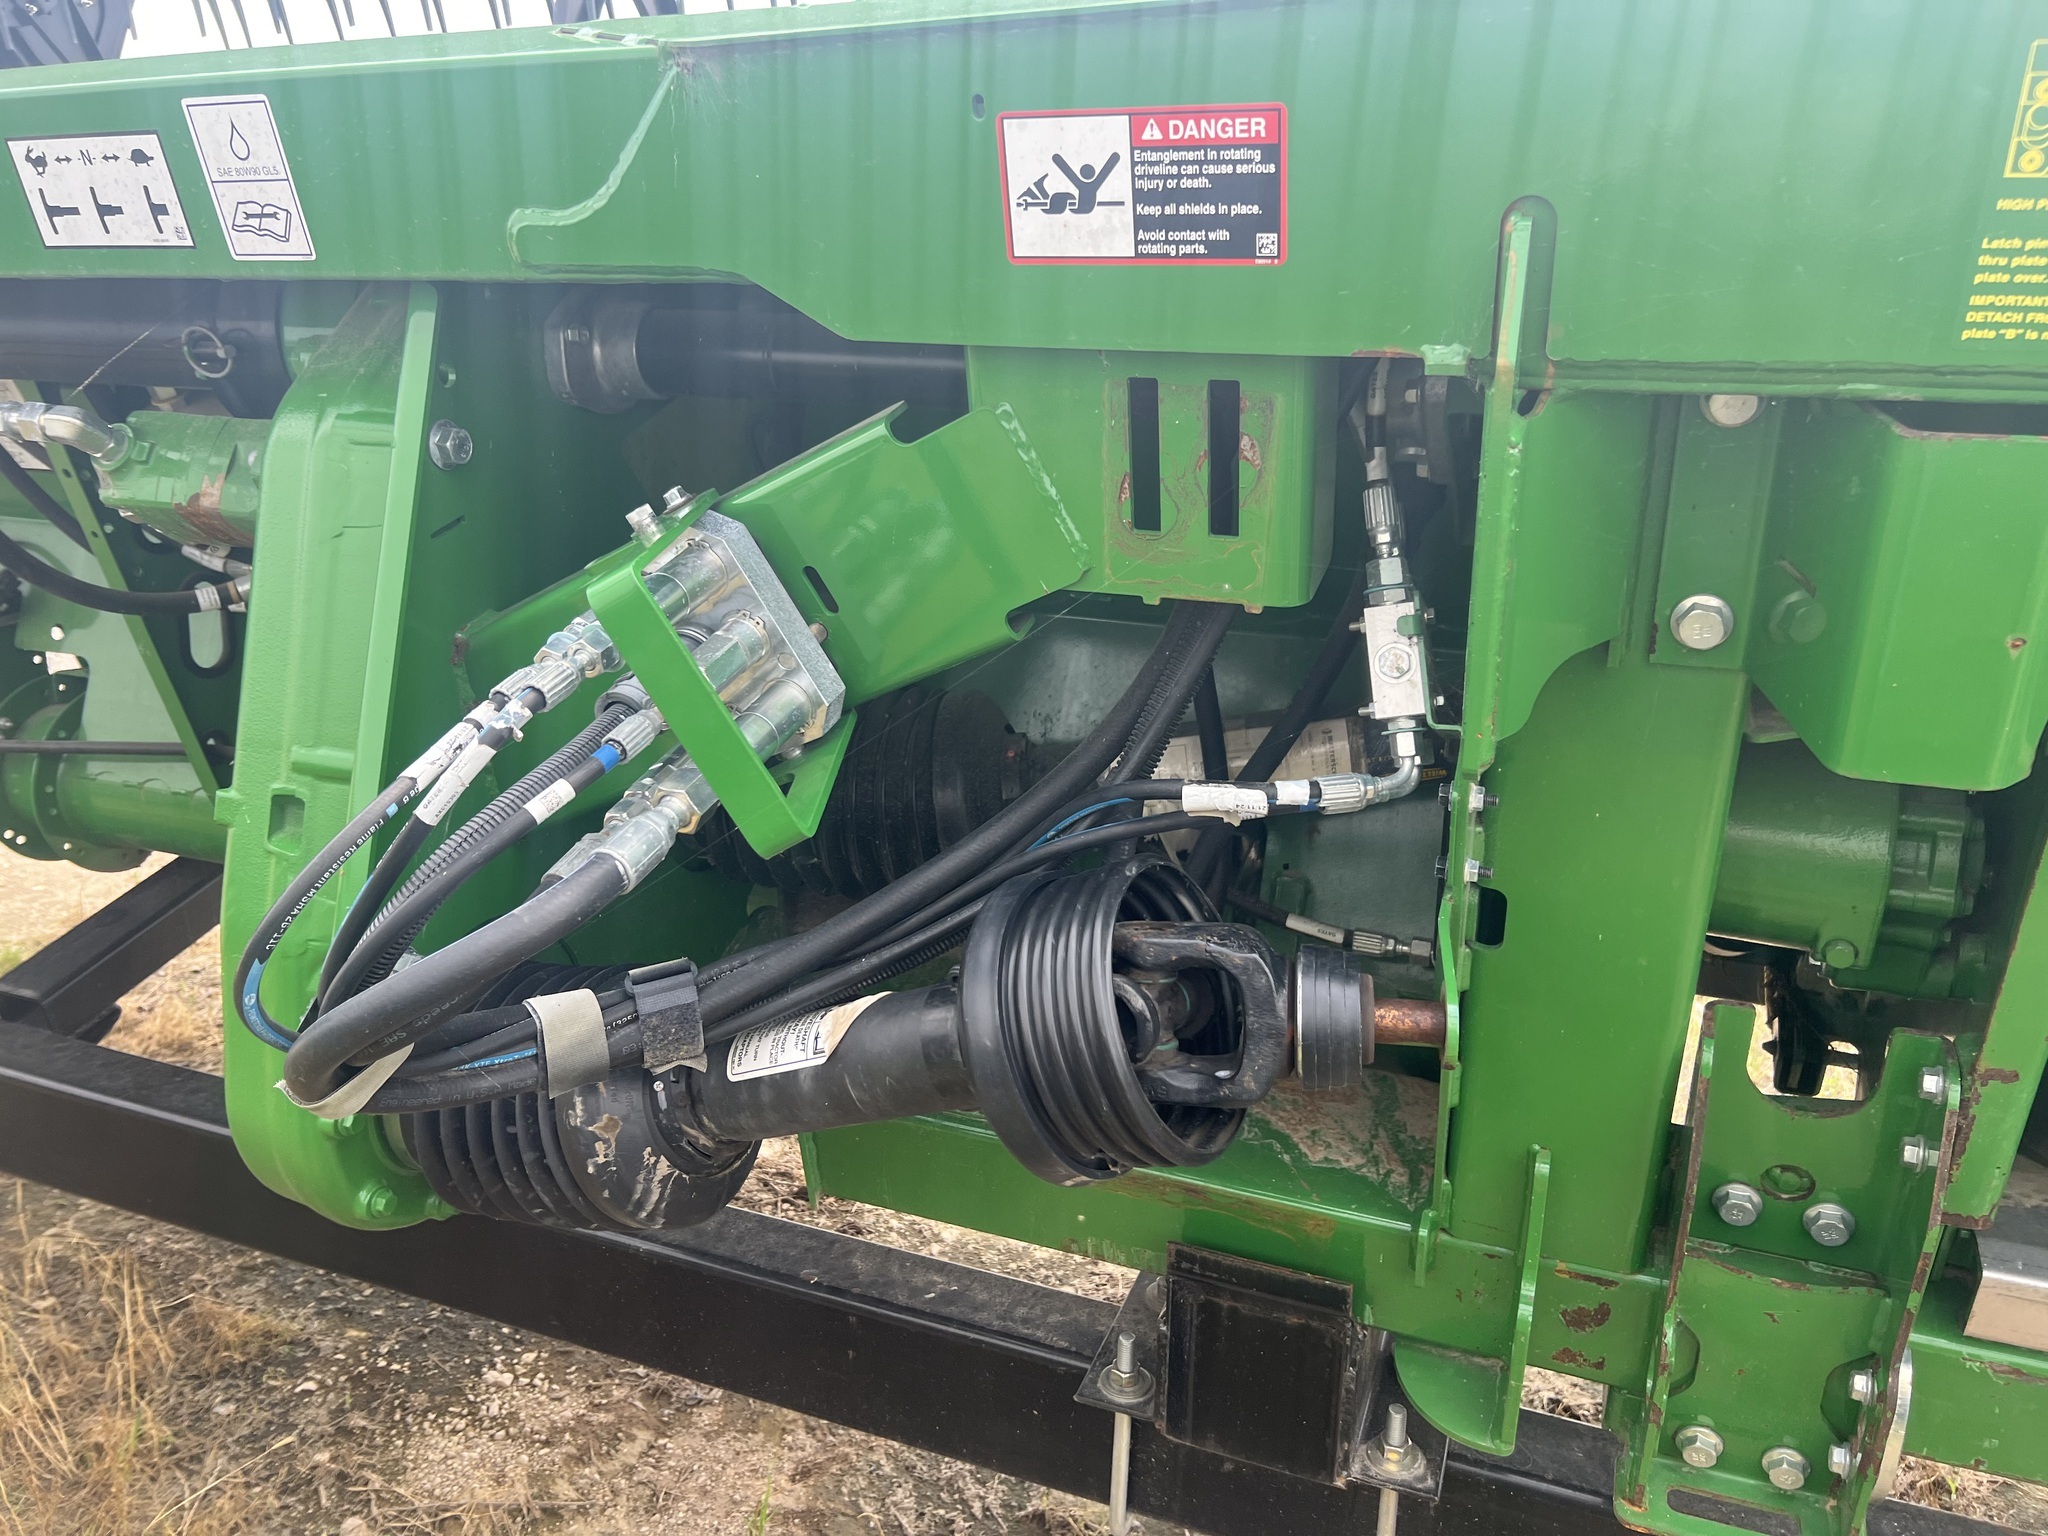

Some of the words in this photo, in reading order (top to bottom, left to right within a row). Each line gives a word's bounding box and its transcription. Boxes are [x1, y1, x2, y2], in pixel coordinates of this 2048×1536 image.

[1168, 117, 1267, 140] DANGER
[1134, 148, 1205, 164] Entanglement
[1207, 149, 1218, 161] in
[1220, 148, 1261, 162] rotating
[216, 167, 234, 177] SAE
[234, 166, 261, 177] 80W90
[1134, 163, 1178, 176] driveline
[1181, 165, 1200, 175] can
[1202, 165, 1233, 175] cause
[1236, 162, 1276, 174] serious
[1135, 177, 1164, 192] injury
[1166, 178, 1178, 189] or
[1180, 176, 1212, 189] death.
[1136, 203, 1162, 217] Keep
[1164, 203, 1176, 215] all
[1178, 203, 1216, 215] shields
[1218, 203, 1228, 215] in
[1230, 203, 1263, 217] place.
[1995, 198, 2035, 210] HIGH
[1137, 229, 1166, 241] Avoid
[1168, 229, 1206, 241] contact
[1208, 229, 1230, 241] with
[1137, 243, 1176, 256] rotating
[1178, 243, 1208, 256] parts.
[1981, 237, 2023, 249] Latch
[1978, 254, 2009, 266] thru
[2010, 255, 2048, 269] plate
[1973, 271, 2011, 285] plate
[1965, 311, 2024, 323] DETACH
[1961, 328, 1997, 341] plate
[2025, 328, 2039, 340] is
[356, 818, 385, 846] Flame
[314, 844, 358, 889] Resistant
